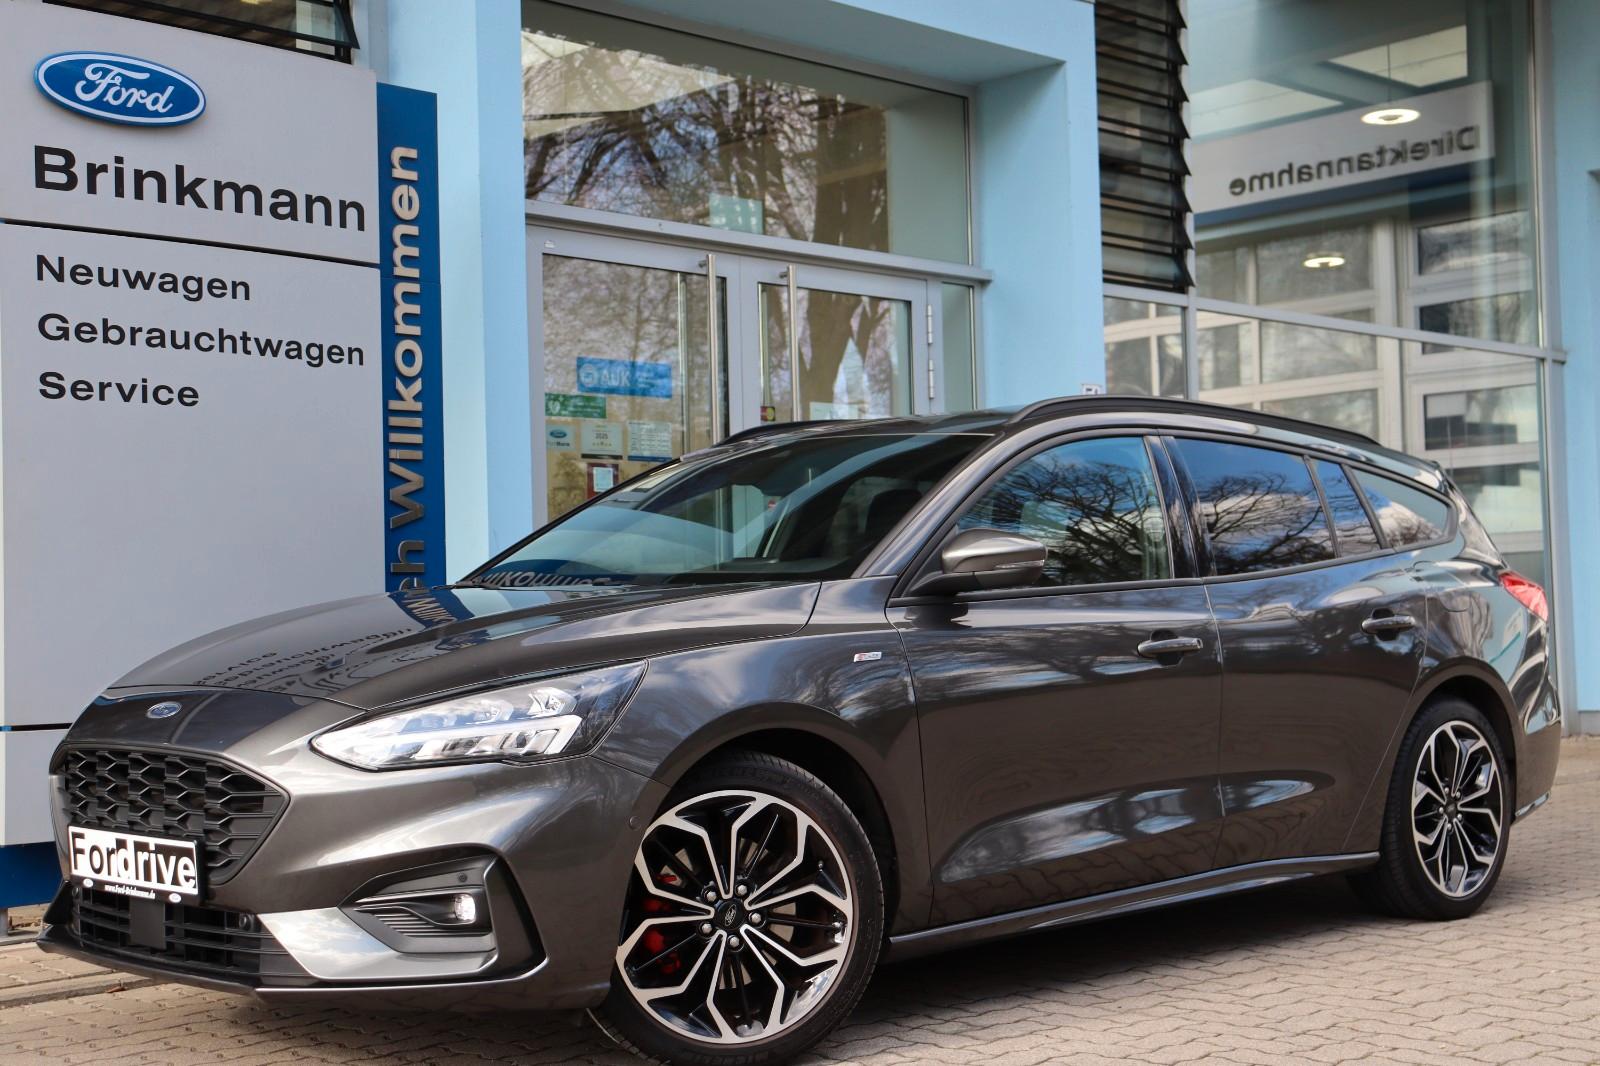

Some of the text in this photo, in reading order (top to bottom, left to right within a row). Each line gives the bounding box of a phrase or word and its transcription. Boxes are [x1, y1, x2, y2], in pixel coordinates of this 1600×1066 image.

[74, 62, 173, 114] Ford
[34, 144, 366, 232] Brinkmann
[35, 253, 250, 302] Neuwagen
[37, 312, 365, 368] Gebrauchtwagen
[38, 371, 200, 407] Service
